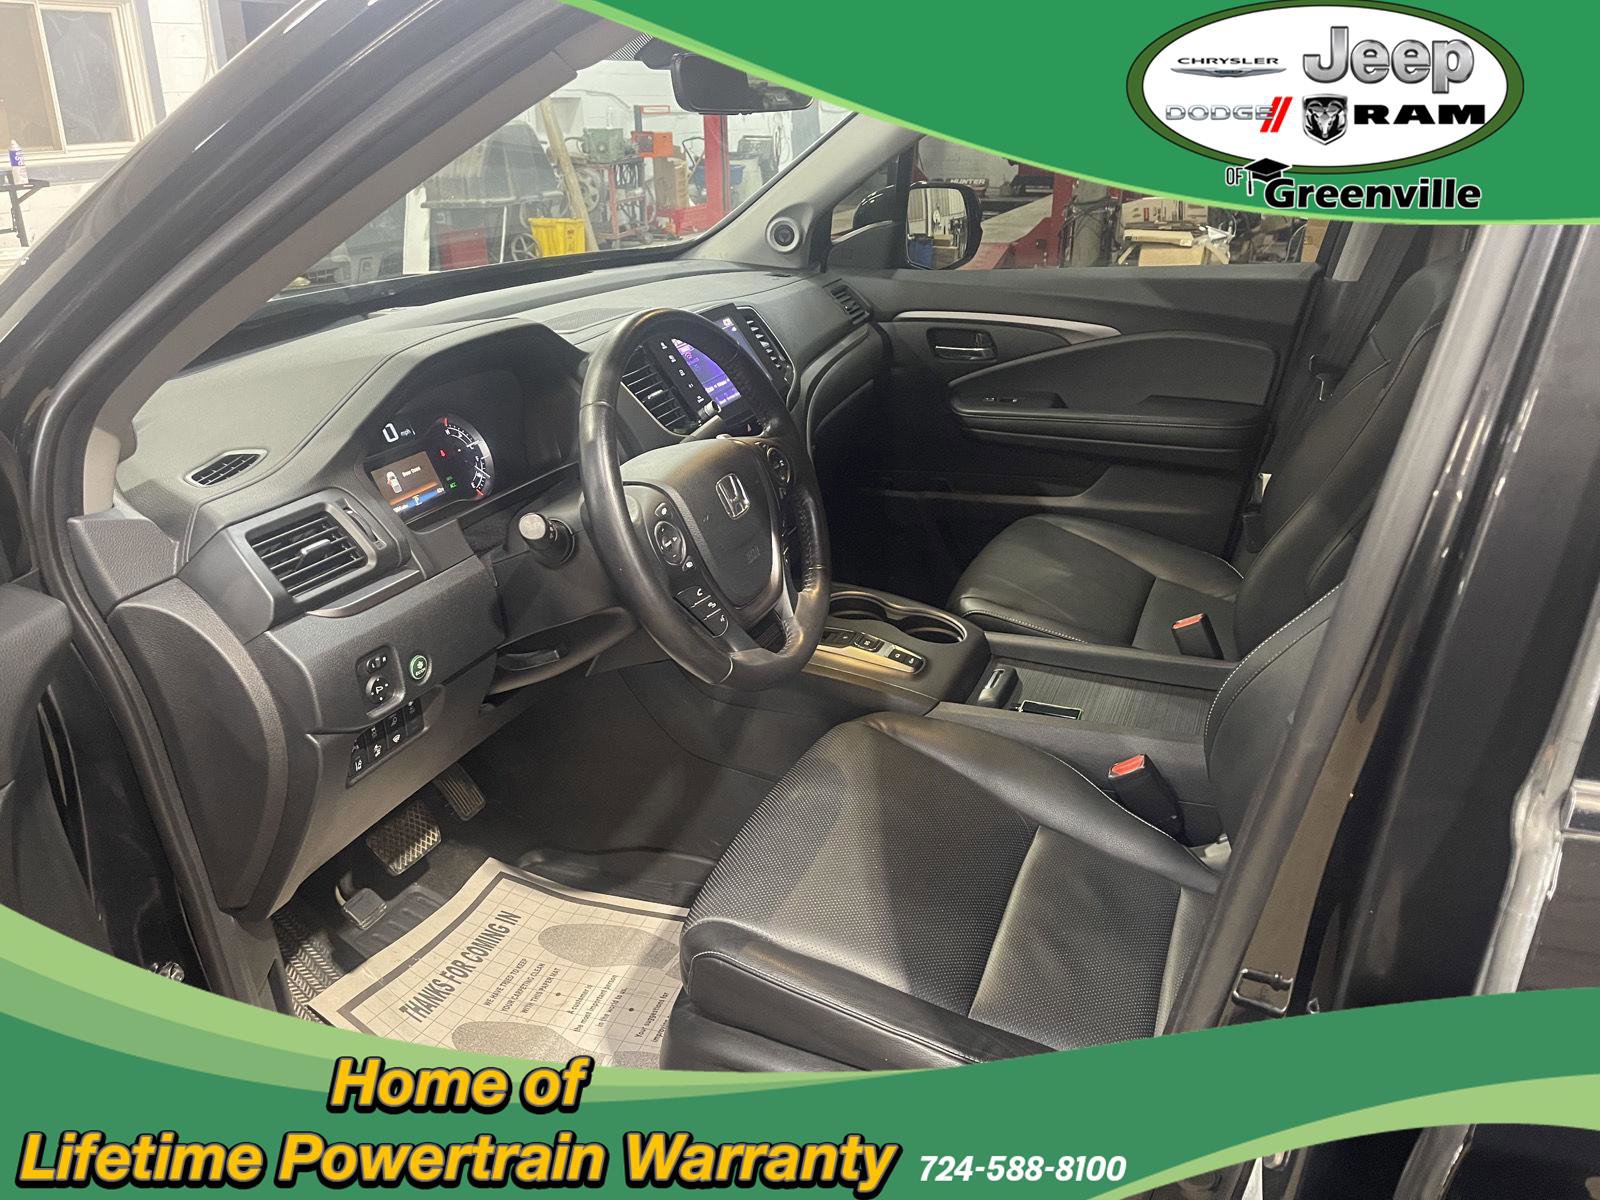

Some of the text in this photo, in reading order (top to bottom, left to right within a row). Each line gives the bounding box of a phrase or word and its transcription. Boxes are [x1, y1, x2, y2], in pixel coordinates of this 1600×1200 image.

[398, 910, 522, 1023] THANKS FOR COMING IN
[483, 958, 527, 1007] WE HAVE TRIED TO KEEP
[501, 963, 545, 1012] YOUR CARPETING CLEAN
[521, 967, 560, 1013] WITH THIS PAPER MAT
[571, 989, 589, 1010] customer
[573, 974, 618, 1033] the most important person
[607, 998, 619, 1013] world
[634, 992, 670, 1038] Your suggestions for
